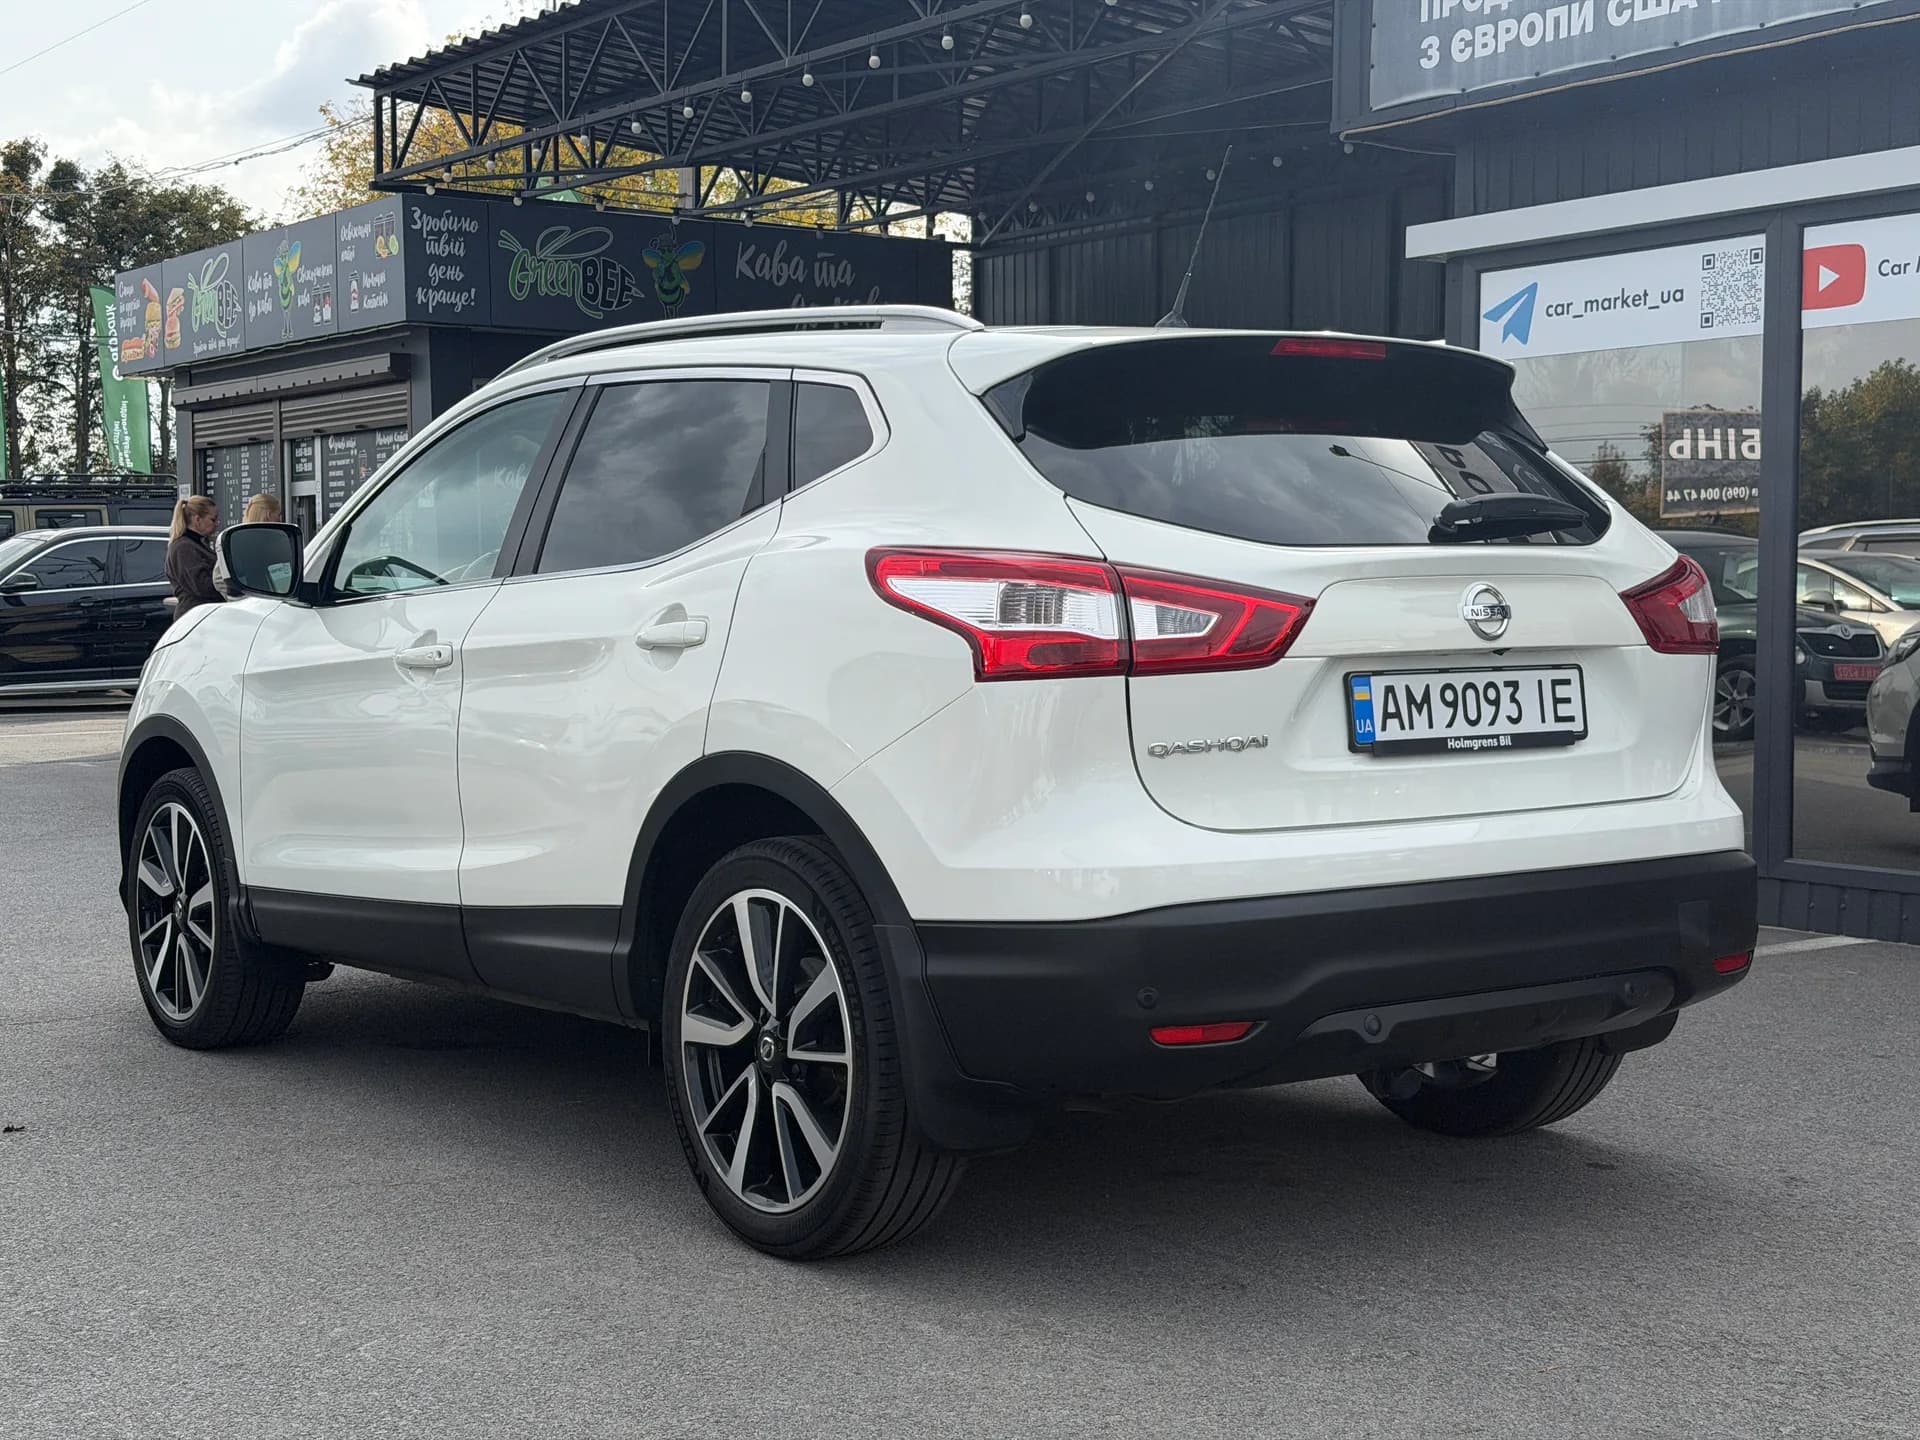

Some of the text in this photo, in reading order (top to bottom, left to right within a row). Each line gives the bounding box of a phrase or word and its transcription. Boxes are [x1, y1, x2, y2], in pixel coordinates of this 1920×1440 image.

[1419, 35, 1440, 69] З
[1451, 0, 1594, 63] ЄВРОПИ
[410, 206, 480, 238] Зробимо
[425, 232, 466, 258] твій
[427, 262, 465, 287] день
[735, 239, 856, 289] Кава та
[1878, 258, 1911, 277] Car
[416, 286, 477, 314] краще!
[1545, 287, 1685, 319] car_market_ua
[1470, 606, 1509, 617] NISSAN
[1356, 719, 1374, 734] UA
[1537, 678, 1576, 724] IE
[1147, 734, 1269, 759] QASHQAI
[1447, 735, 1512, 750] Holmgrens Bil
